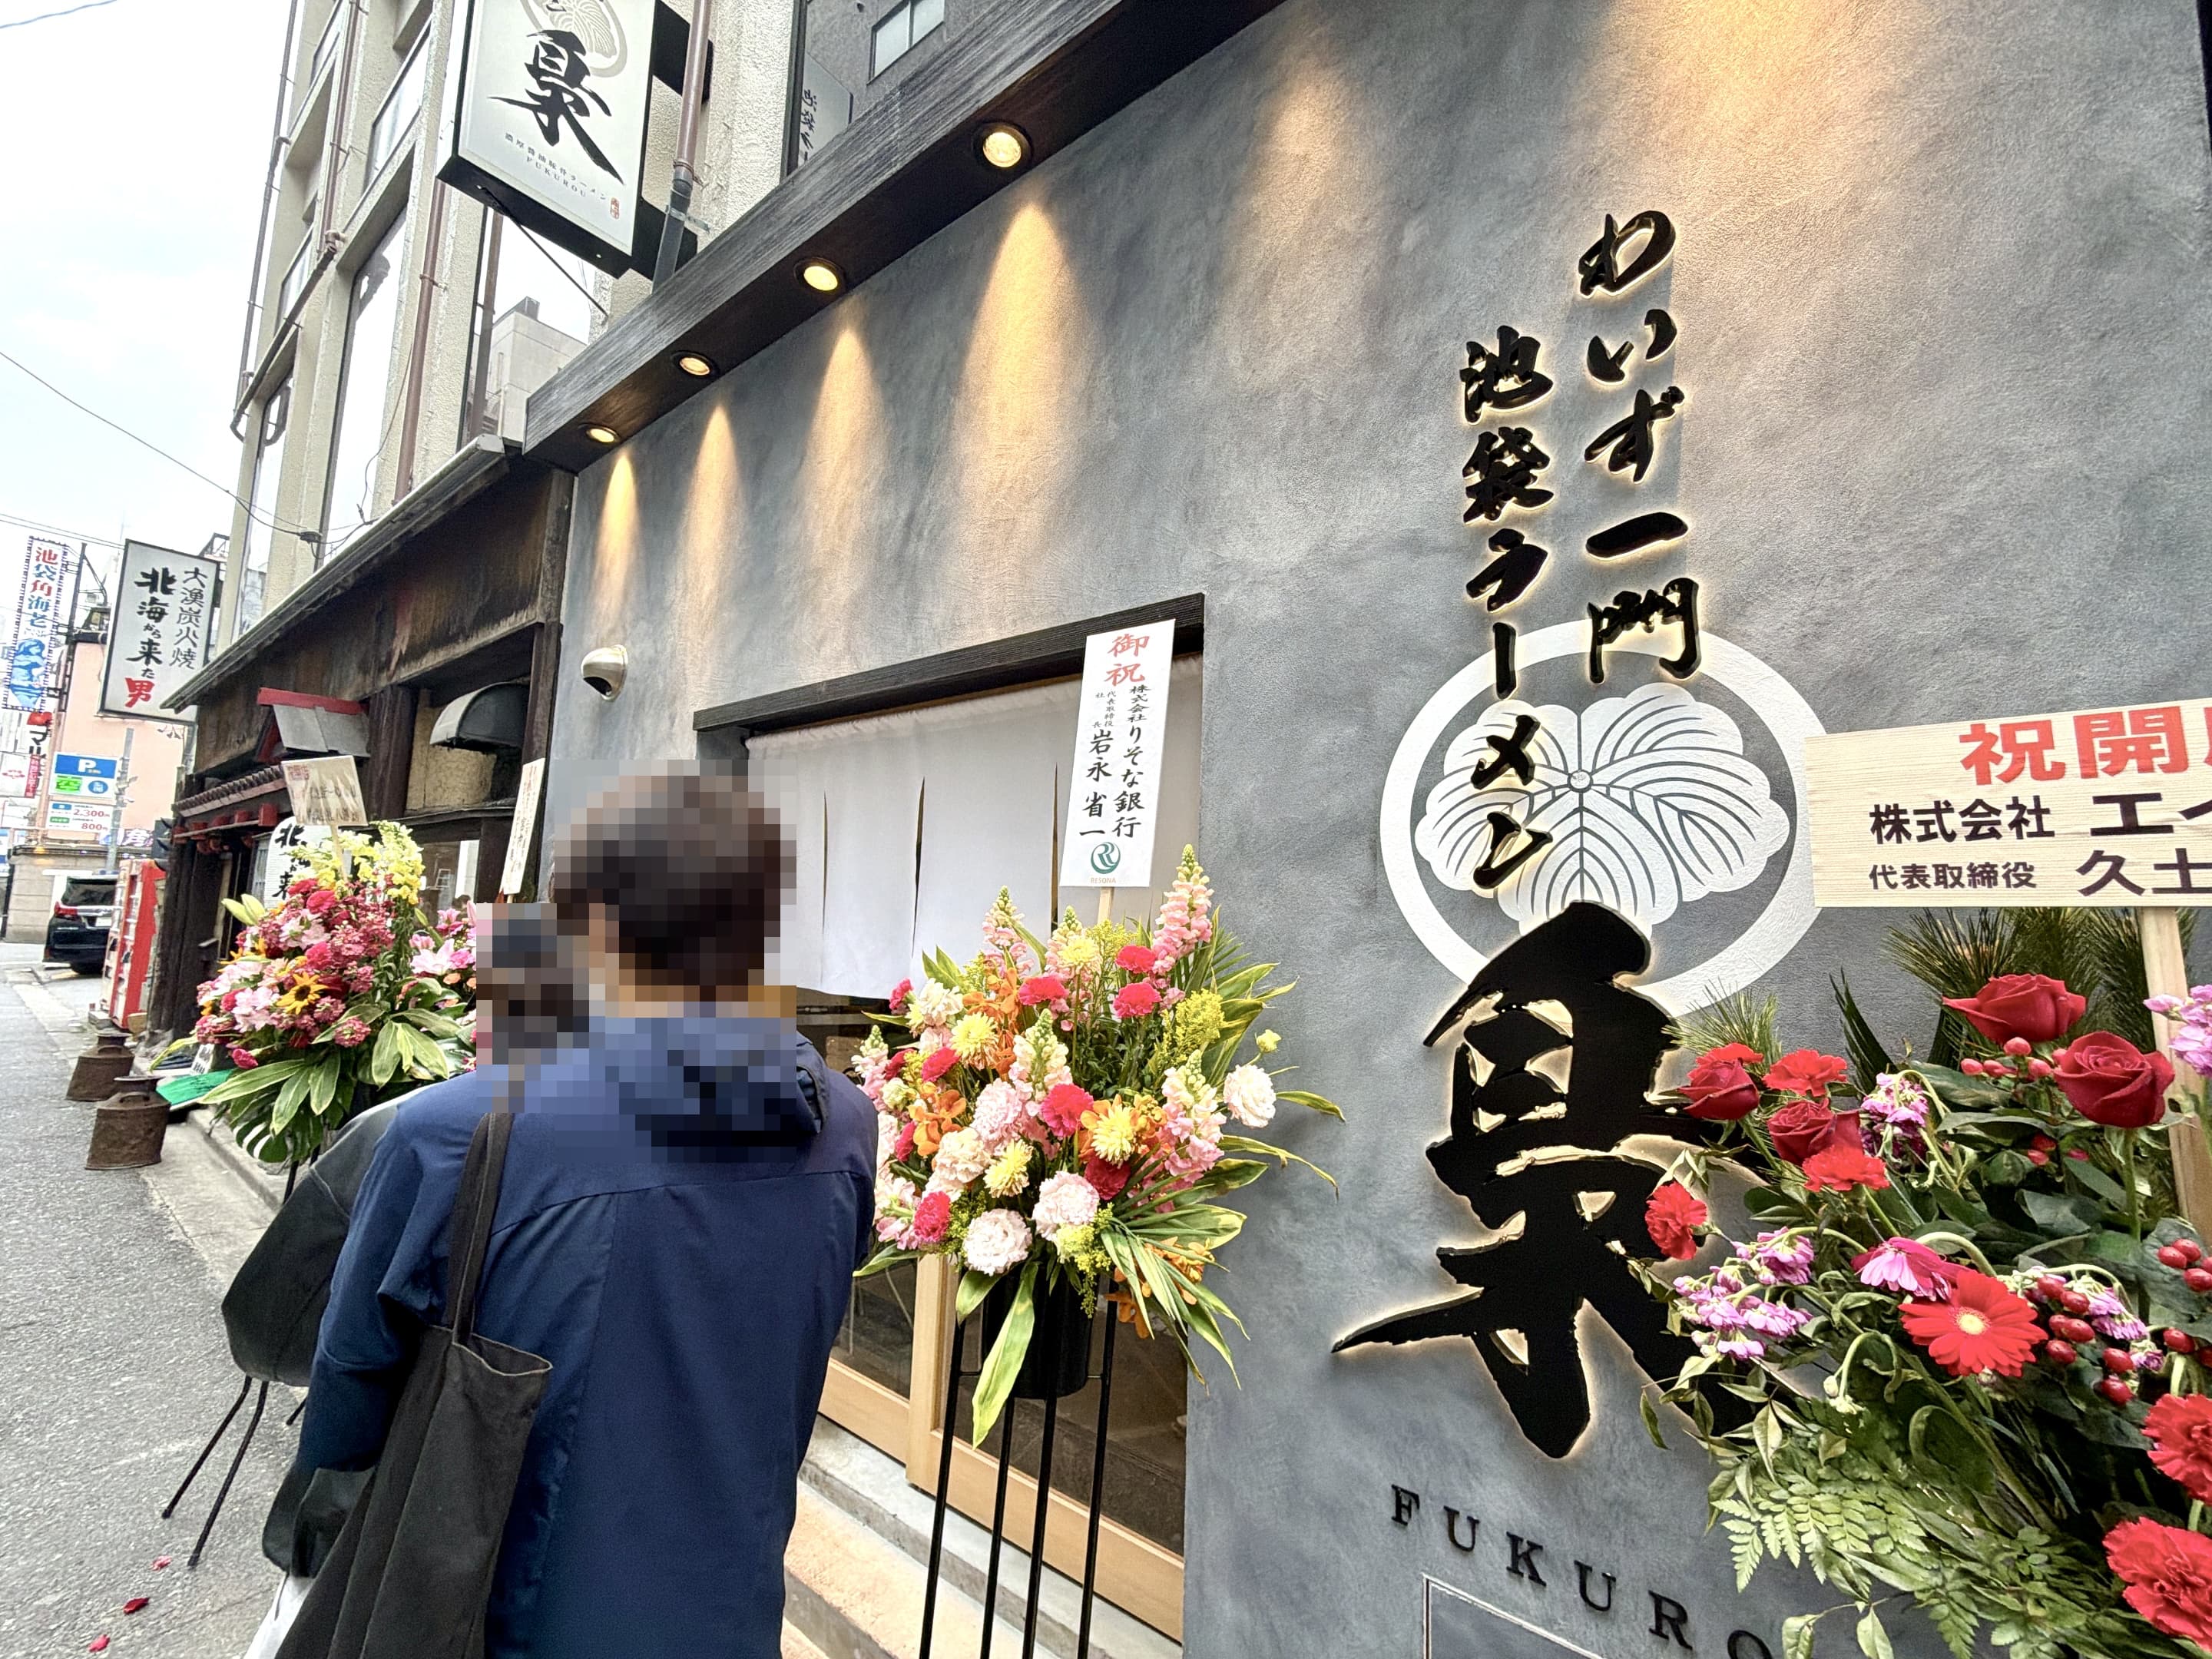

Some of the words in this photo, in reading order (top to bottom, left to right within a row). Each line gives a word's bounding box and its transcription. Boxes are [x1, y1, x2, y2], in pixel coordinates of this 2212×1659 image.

[1578, 210, 1700, 684] わいず一門
[125, 567, 177, 708] 北海から来た男
[169, 567, 208, 670] 大漁炭火焼
[1459, 325, 1553, 892] 池袋ラーメン
[1104, 633, 1151, 687] 御祝
[1959, 706, 2212, 786] 祝開
[1869, 795, 2055, 845] 株式会社
[1869, 861, 2037, 889] 代表取締役
